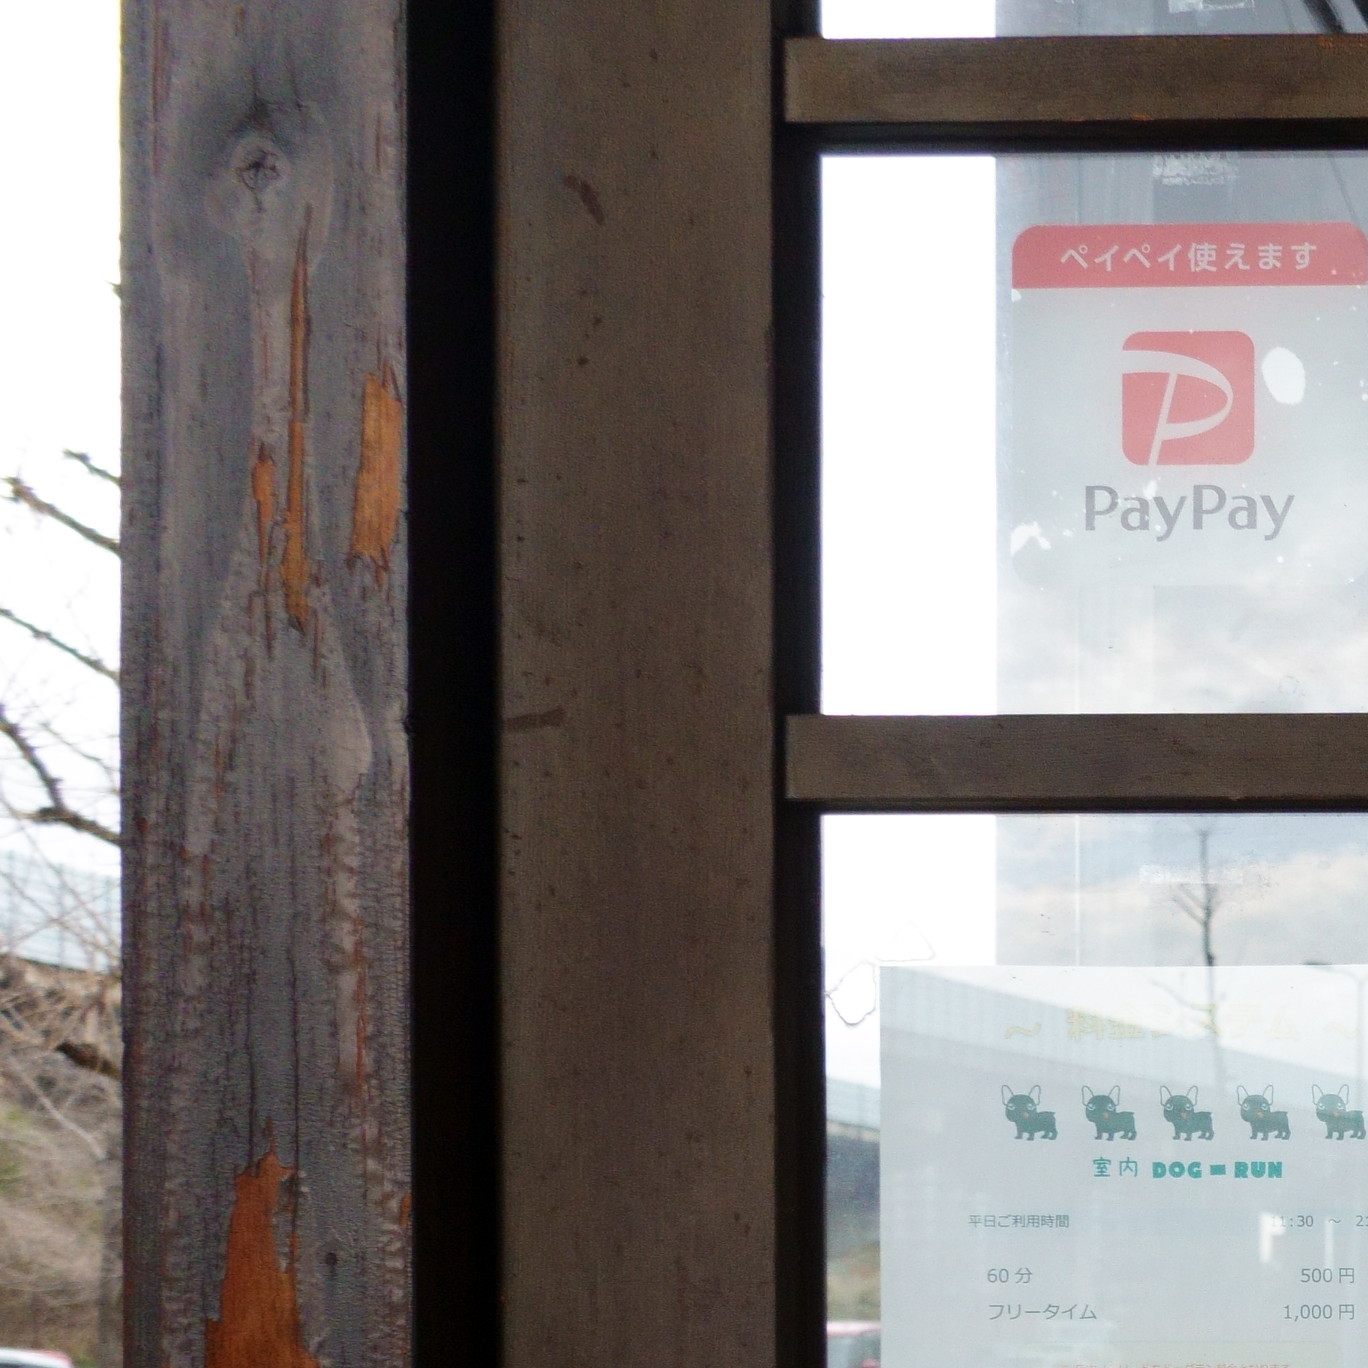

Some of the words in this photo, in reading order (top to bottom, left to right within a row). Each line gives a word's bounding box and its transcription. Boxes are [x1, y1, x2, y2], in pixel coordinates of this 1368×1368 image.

[1060, 242, 1318, 272] ペイペイ使えます
[1084, 484, 1296, 541] PayPay
[968, 1213, 1070, 1229] 平日ご利用時間
[988, 1303, 1097, 1322] フリータイム
